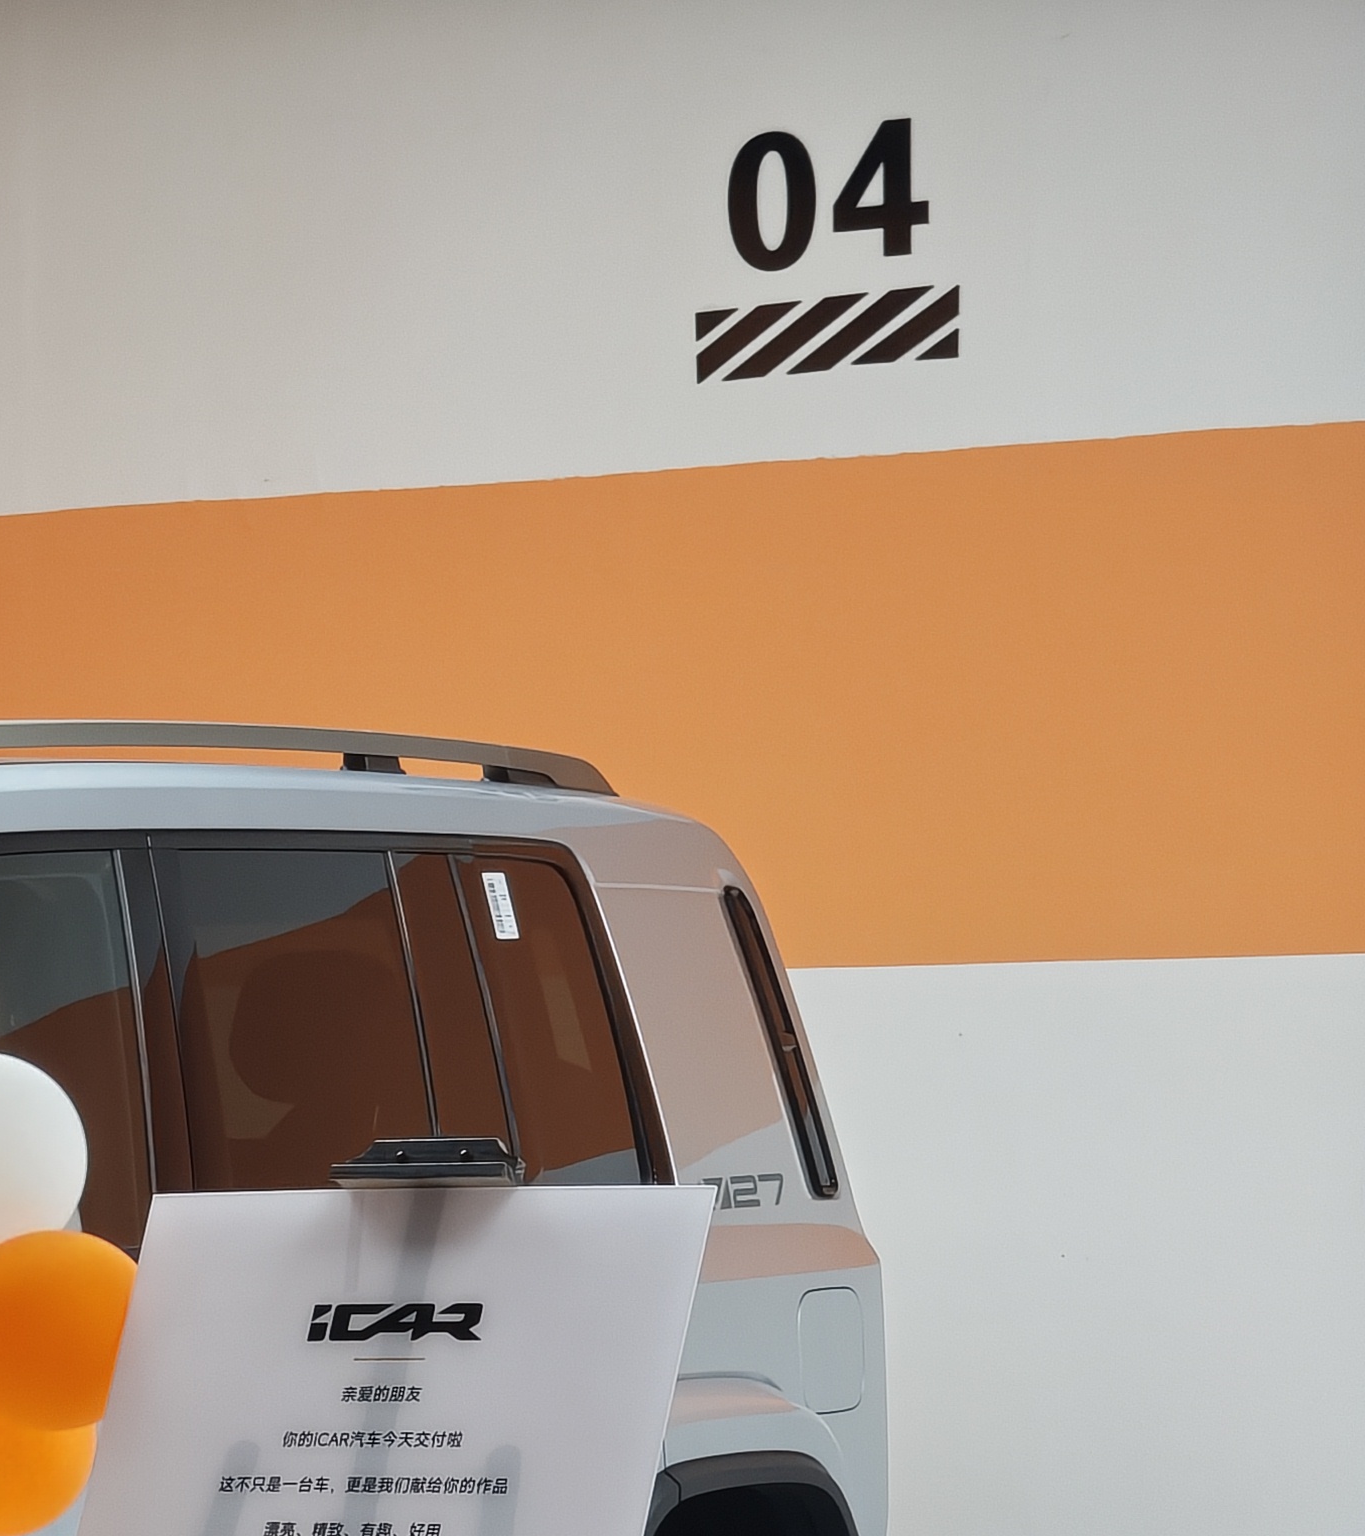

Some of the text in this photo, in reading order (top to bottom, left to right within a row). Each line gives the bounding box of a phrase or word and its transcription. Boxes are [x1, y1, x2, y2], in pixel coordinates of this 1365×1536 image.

[727, 117, 931, 272] 04
[340, 1384, 423, 1403] 亲爱的朋友
[217, 1475, 509, 1496] 这不只是一台车，更是我们献给你的作品
